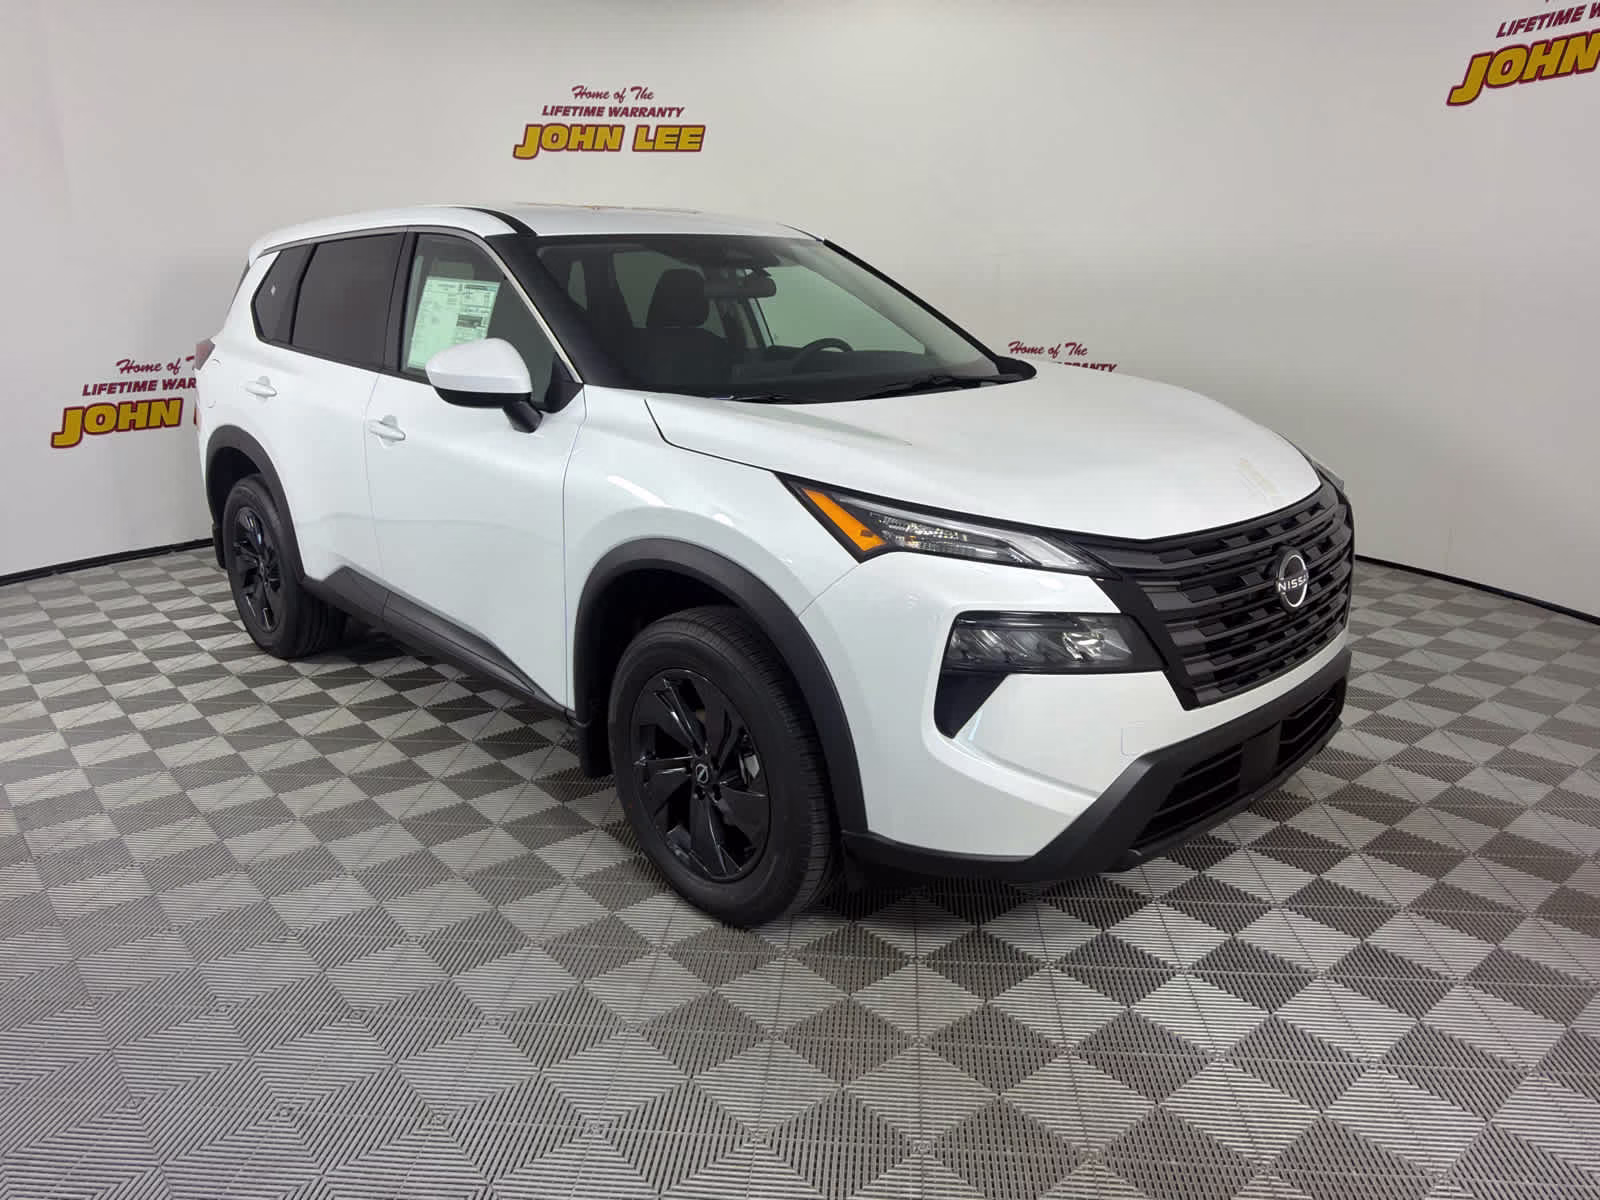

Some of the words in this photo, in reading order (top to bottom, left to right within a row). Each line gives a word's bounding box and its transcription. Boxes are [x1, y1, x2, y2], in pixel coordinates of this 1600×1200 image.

[1496, 5, 1587, 38] LIFETIME
[1446, 29, 1600, 106] JOHN
[571, 85, 610, 100] Home
[613, 87, 627, 103] of
[630, 86, 655, 100] The
[541, 105, 606, 117] LIFETIME
[608, 106, 685, 118] WARRANTY
[512, 123, 626, 160] JOHN
[632, 124, 706, 152] LEE
[1008, 341, 1045, 355] Home
[1047, 343, 1062, 359] of
[1065, 342, 1088, 356] The
[116, 358, 163, 374] Home
[166, 357, 181, 375] of
[82, 380, 157, 397] LIFETIME
[50, 397, 185, 449] JOHN
